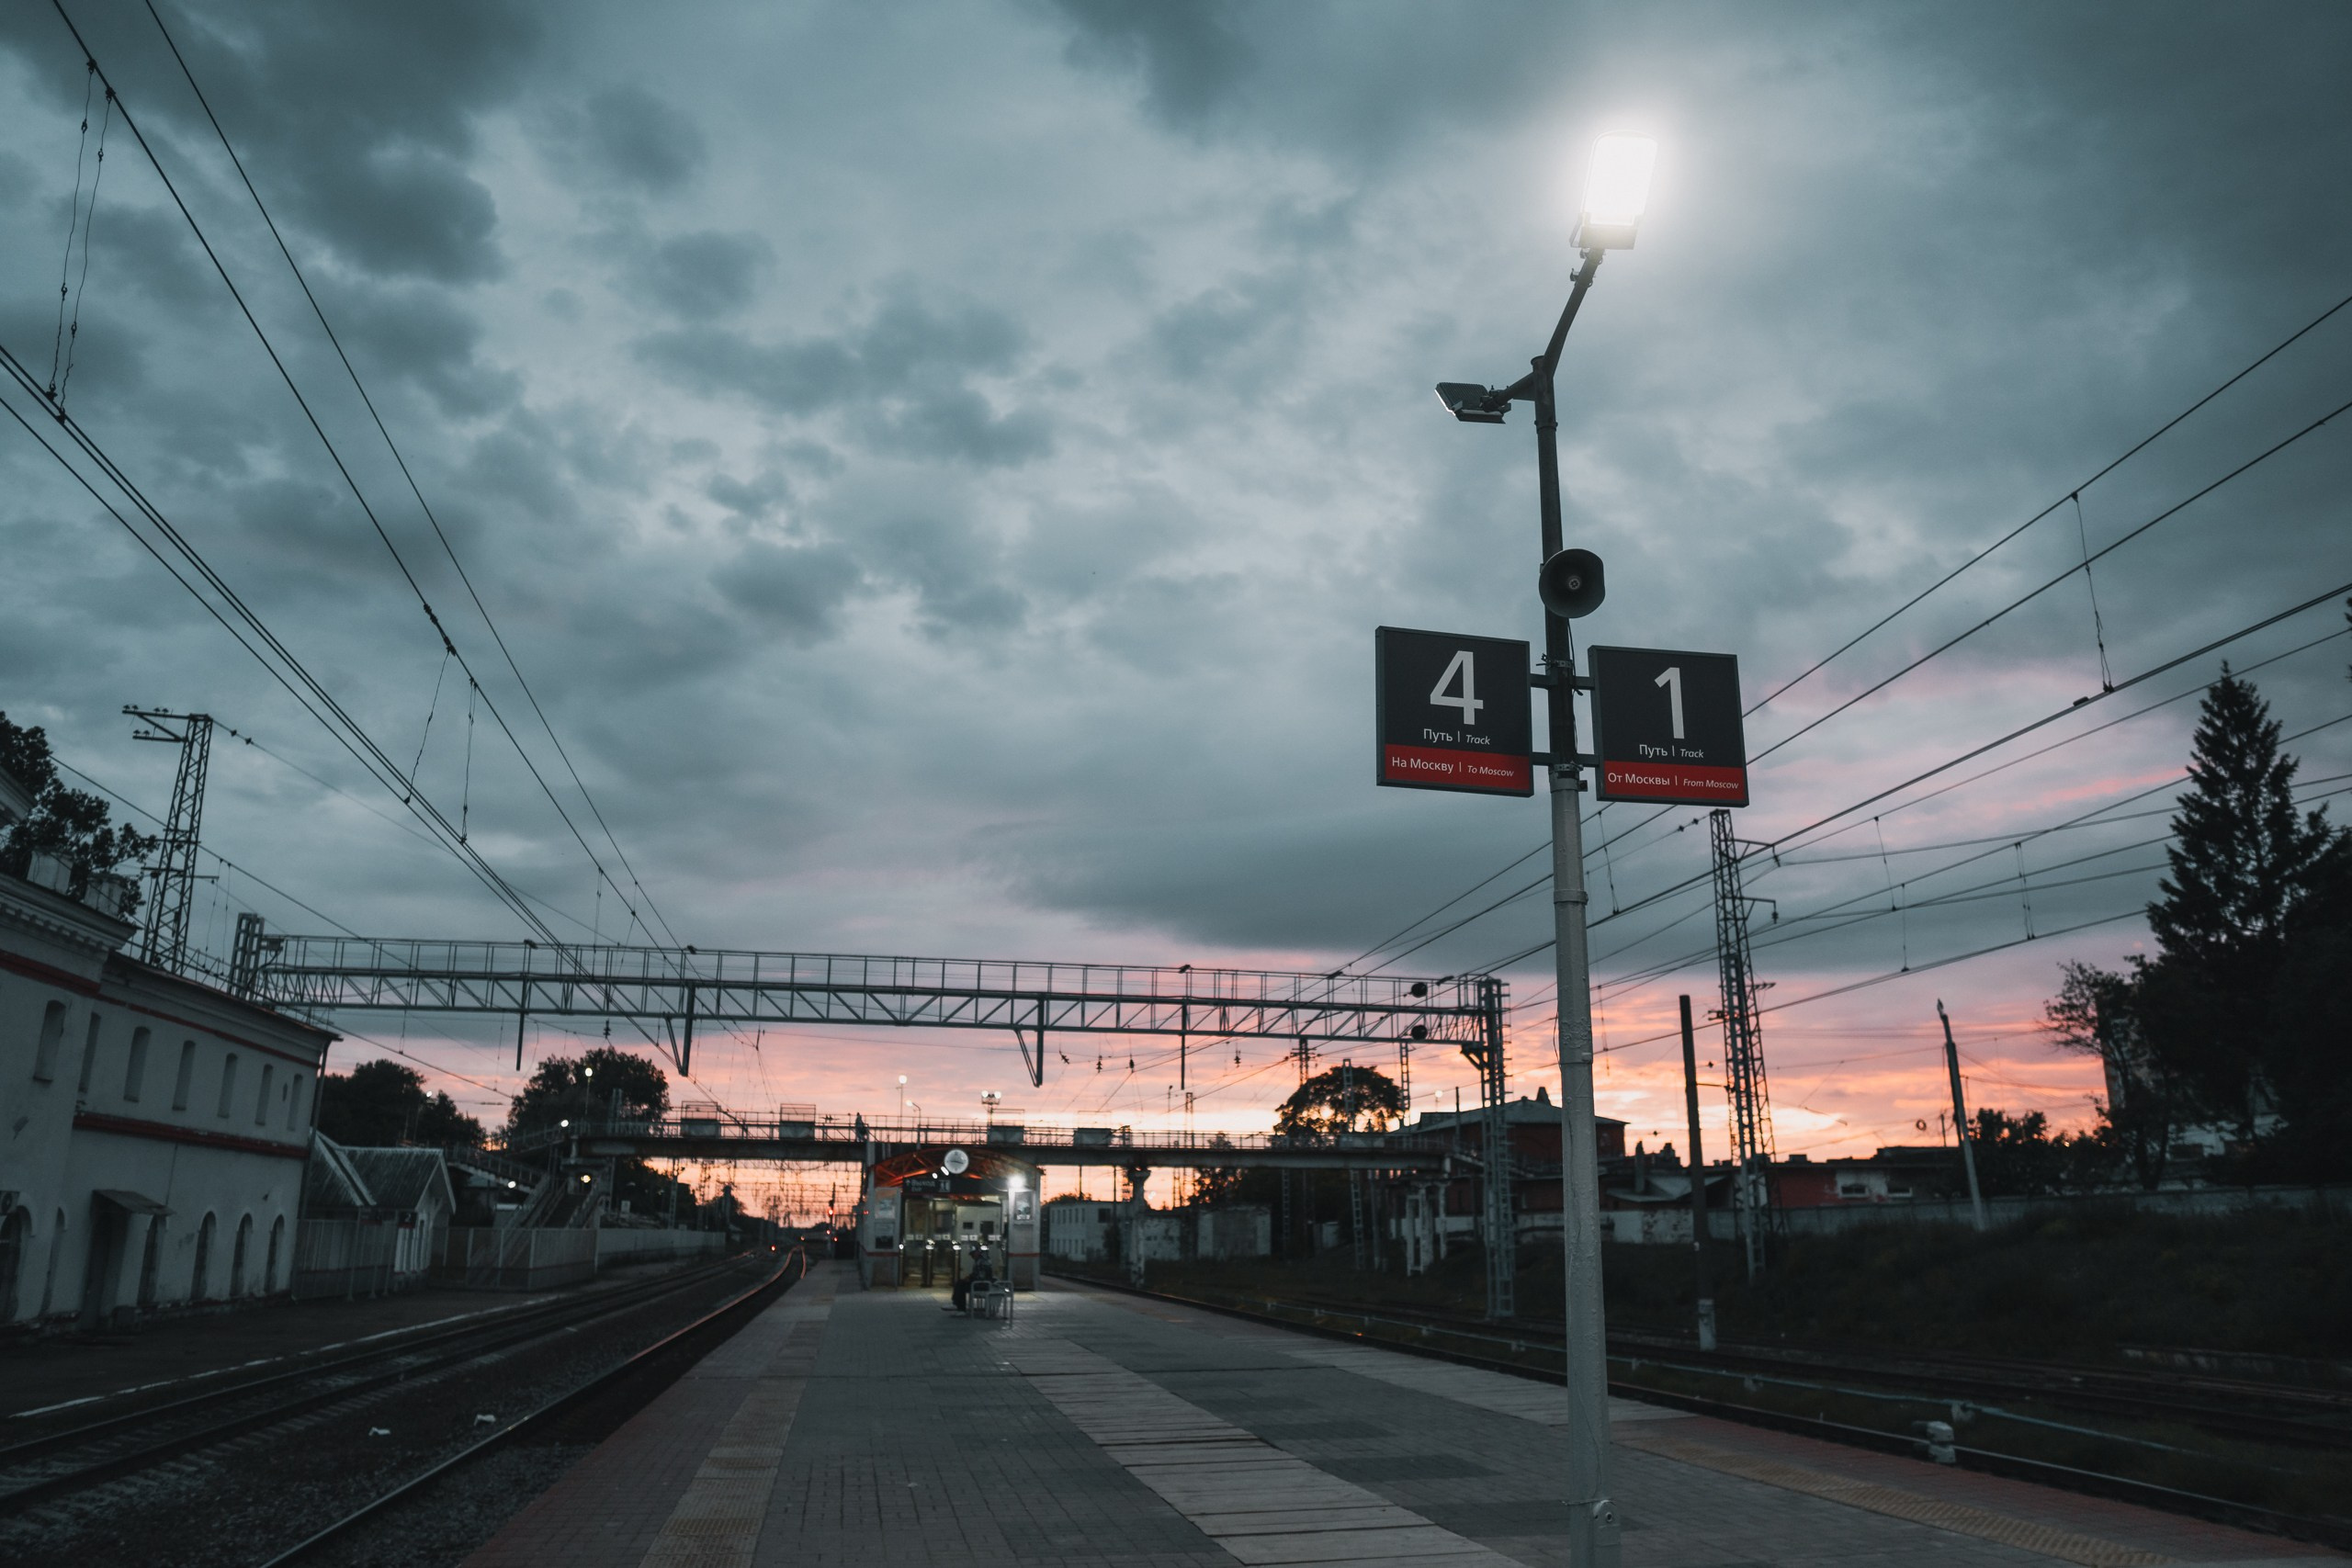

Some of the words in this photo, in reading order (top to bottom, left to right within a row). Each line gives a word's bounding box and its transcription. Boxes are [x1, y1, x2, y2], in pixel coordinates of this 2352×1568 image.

[1430, 650, 1484, 726] 4
[1654, 667, 1685, 739] 1
[1423, 728, 1453, 743] Путь
[1465, 735, 1491, 746] Track
[1639, 744, 1668, 759] Путь
[1679, 749, 1704, 759] Track
[1392, 757, 1407, 768] На
[1410, 758, 1454, 774] Москву
[1467, 765, 1478, 774] To
[1479, 766, 1514, 777] Moscow
[1608, 773, 1623, 784] От
[1625, 773, 1670, 786] Москвы
[1683, 778, 1704, 787] From
[1705, 780, 1739, 790] Moscow
